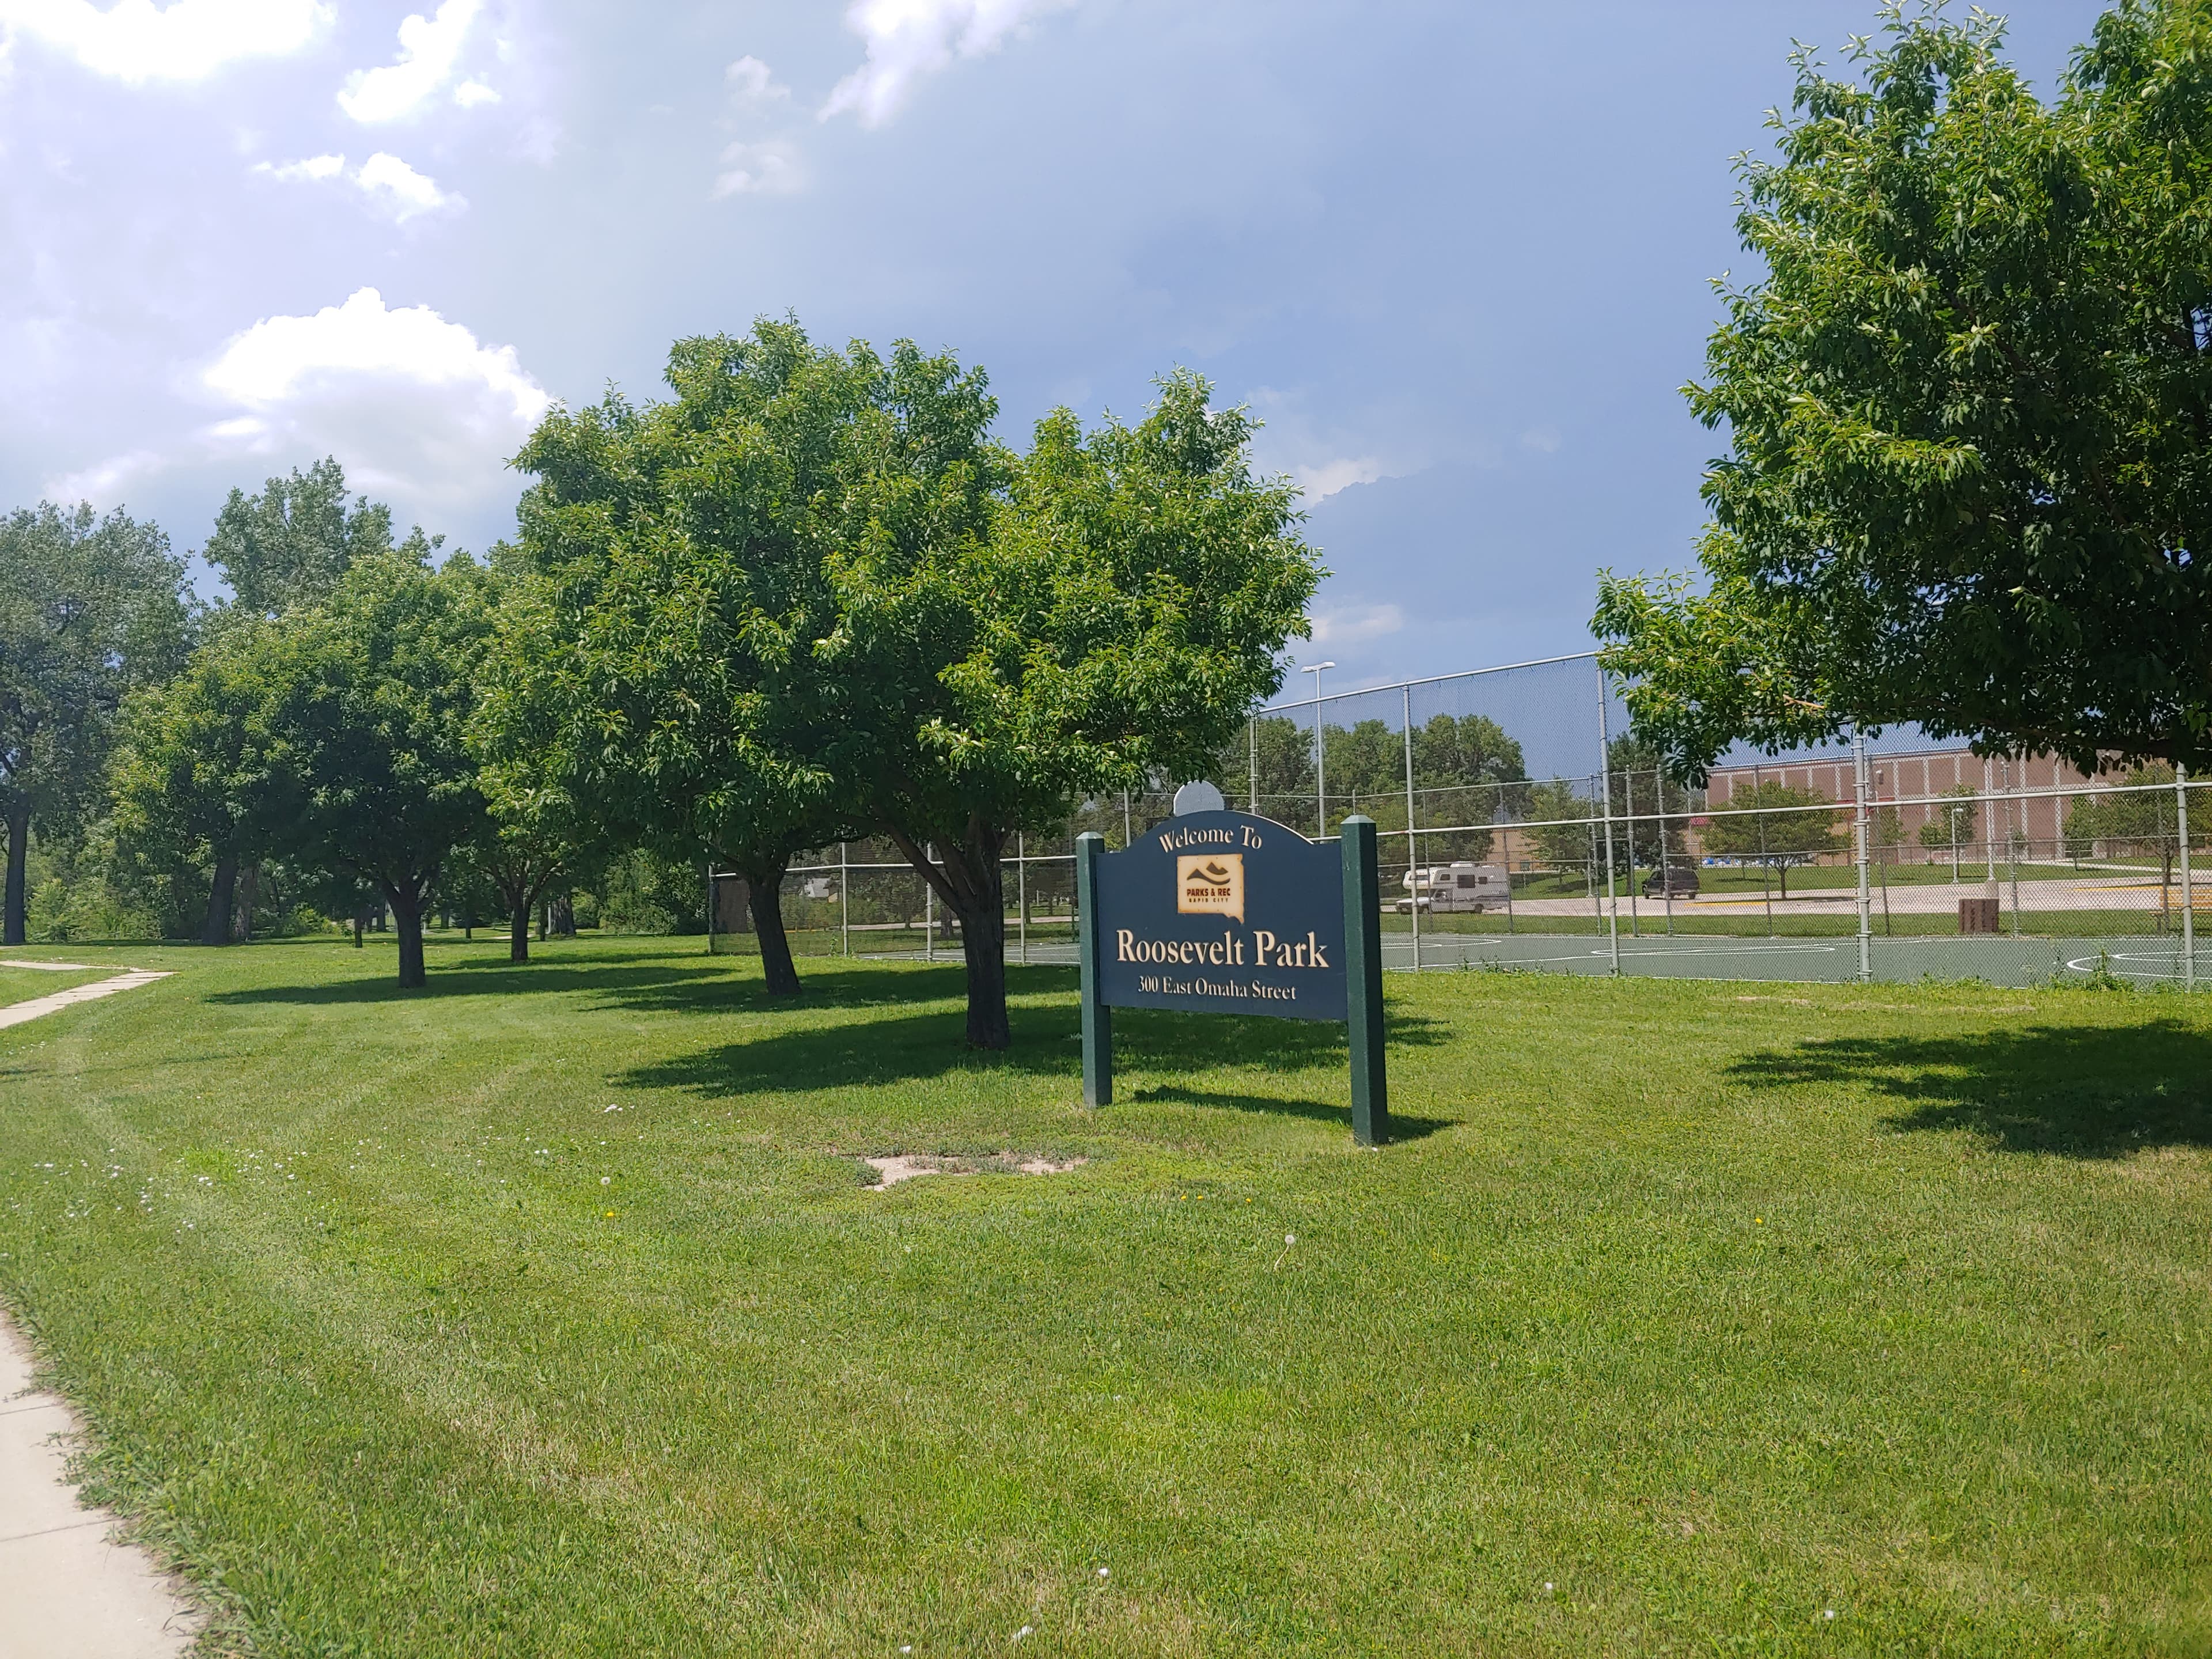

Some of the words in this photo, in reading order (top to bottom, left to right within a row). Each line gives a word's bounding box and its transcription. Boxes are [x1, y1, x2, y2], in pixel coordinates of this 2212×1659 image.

[1159, 827, 1234, 853] Welcome
[1240, 824, 1262, 849] To
[1187, 888, 1209, 896] PARKS
[1210, 888, 1215, 896] &
[1218, 888, 1231, 896] REC
[1117, 929, 1244, 965] Roosevelt
[1253, 931, 1330, 968] Park
[1138, 976, 1158, 993] 300
[1163, 977, 1191, 994] East
[1195, 978, 1247, 997] Omaha
[1252, 980, 1296, 1000] Street
